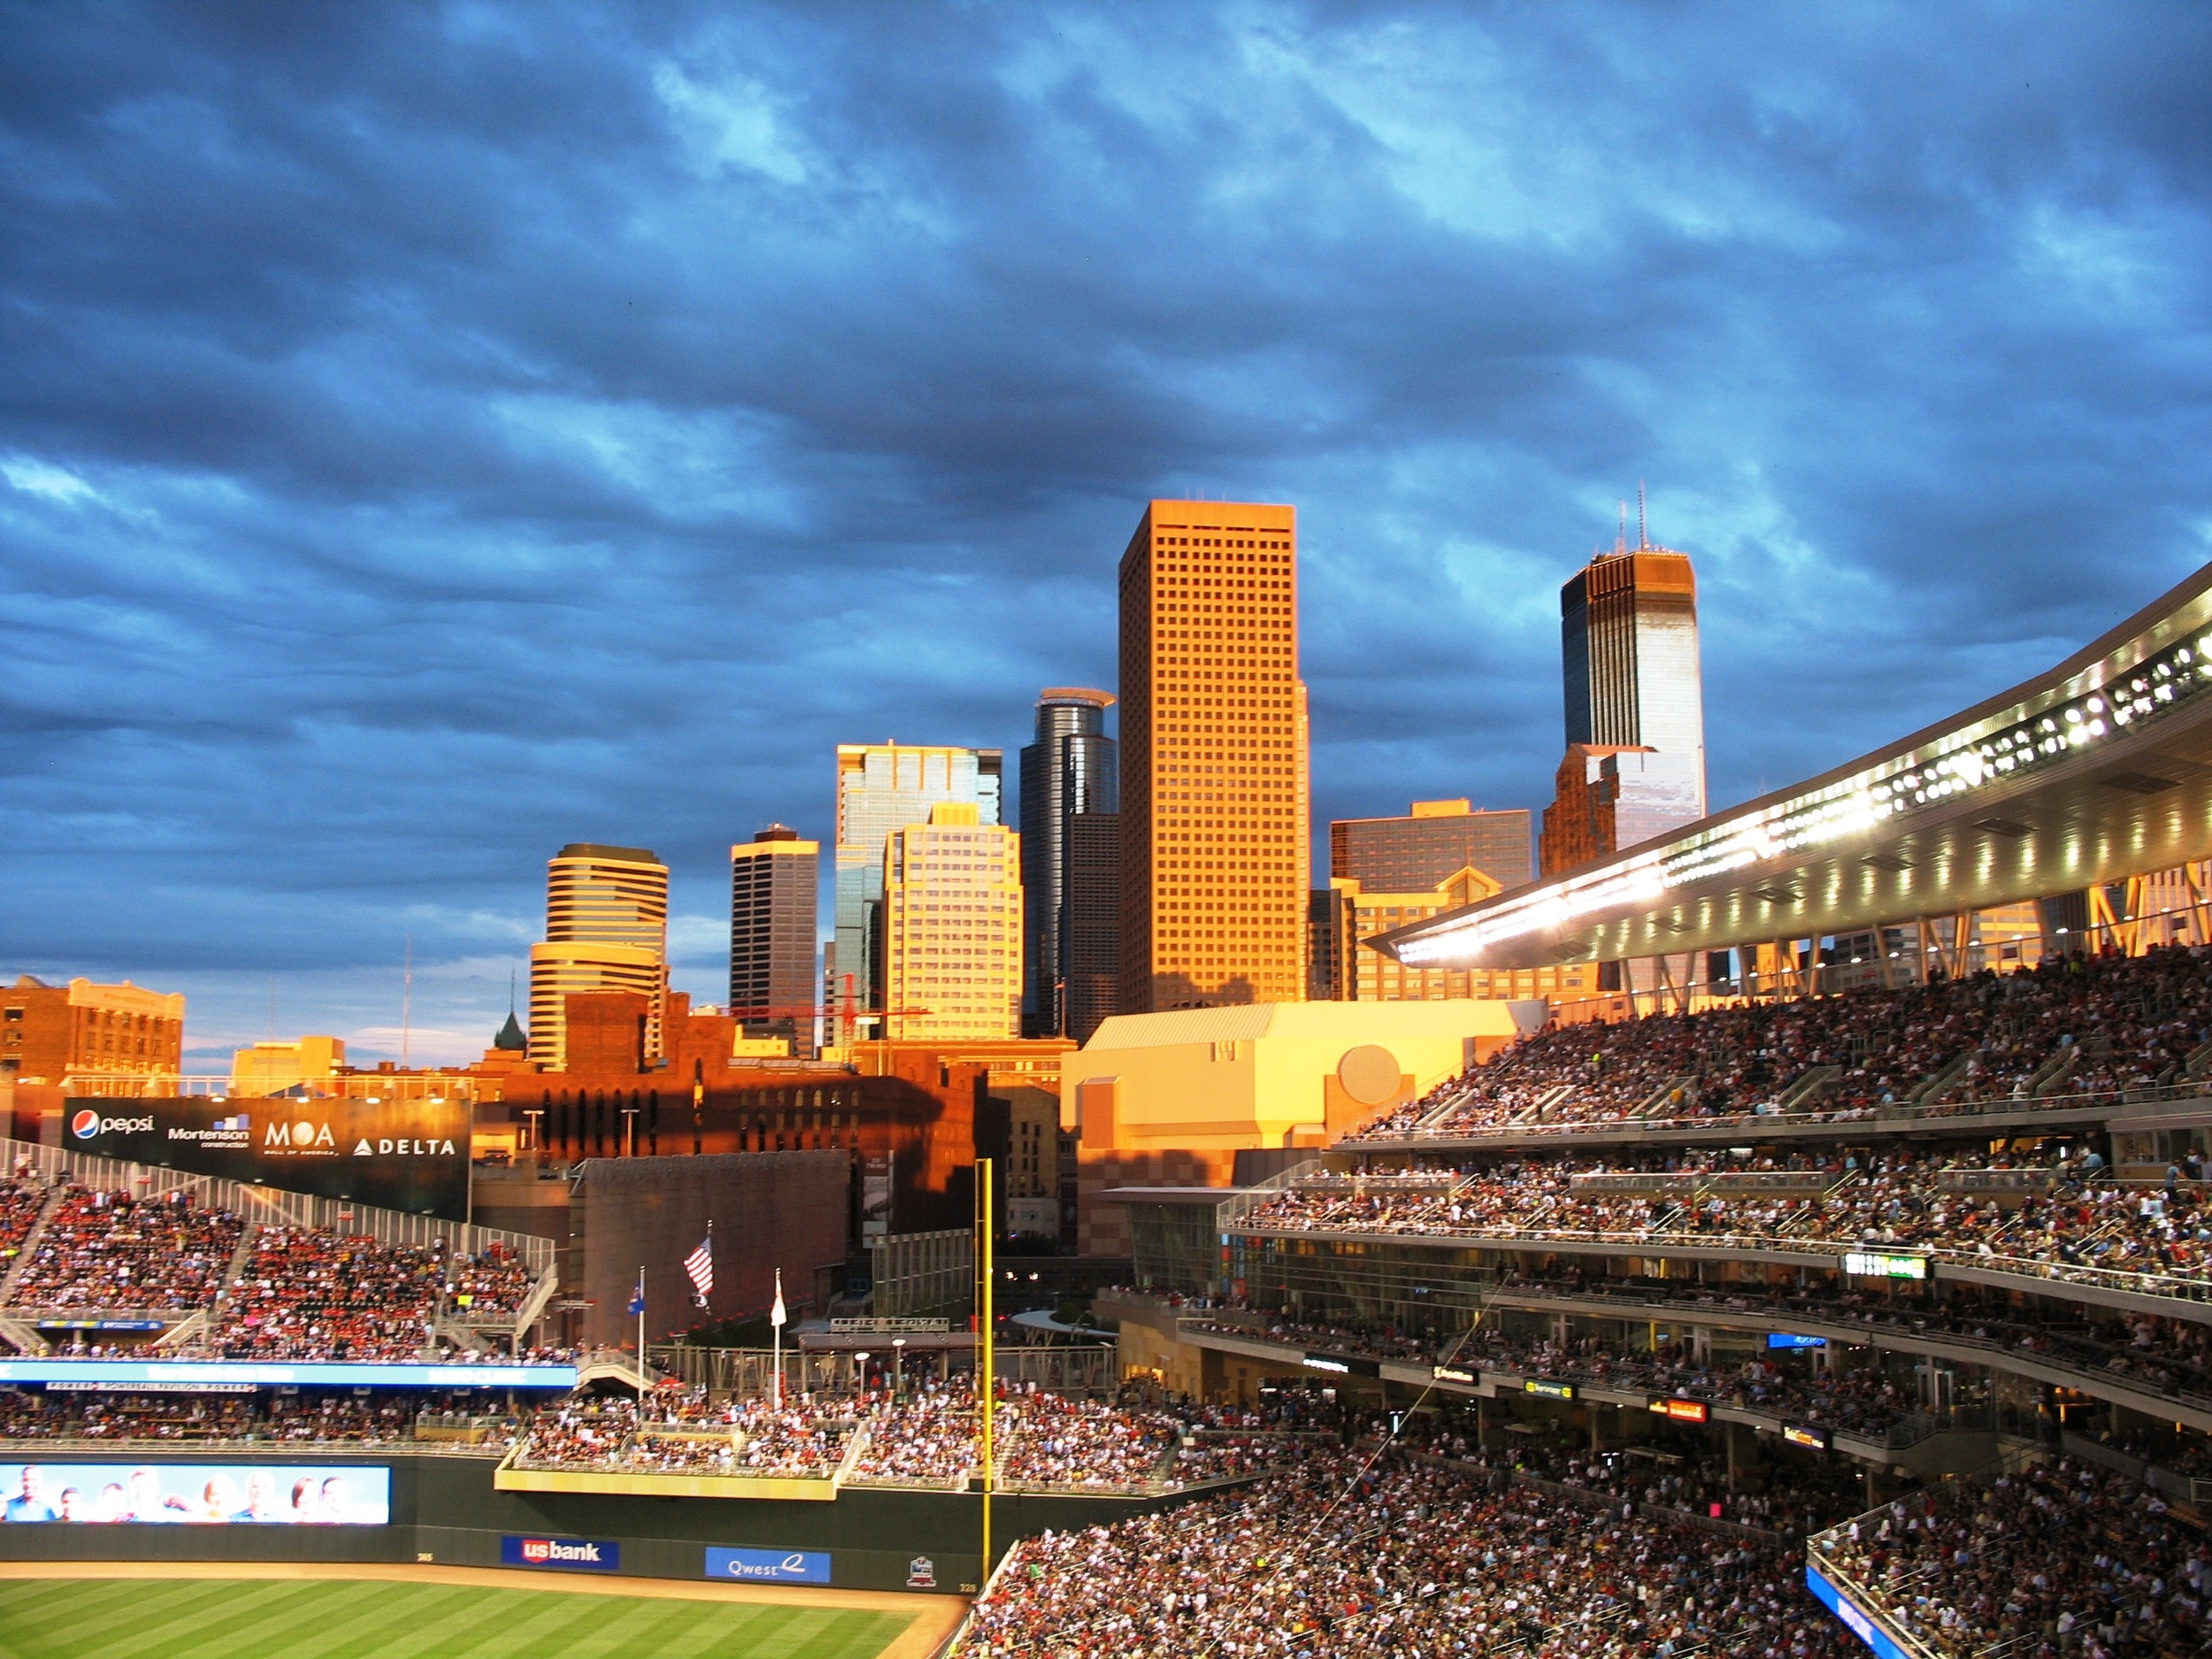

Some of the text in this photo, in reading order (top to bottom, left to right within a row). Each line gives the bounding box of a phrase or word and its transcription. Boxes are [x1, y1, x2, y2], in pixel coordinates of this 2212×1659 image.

[100, 1115, 156, 1135] pepsi
[168, 1127, 250, 1141] Mortenson
[201, 1141, 249, 1149] construction
[379, 1139, 456, 1156] DELTA
[728, 1561, 779, 1576] Qwest
